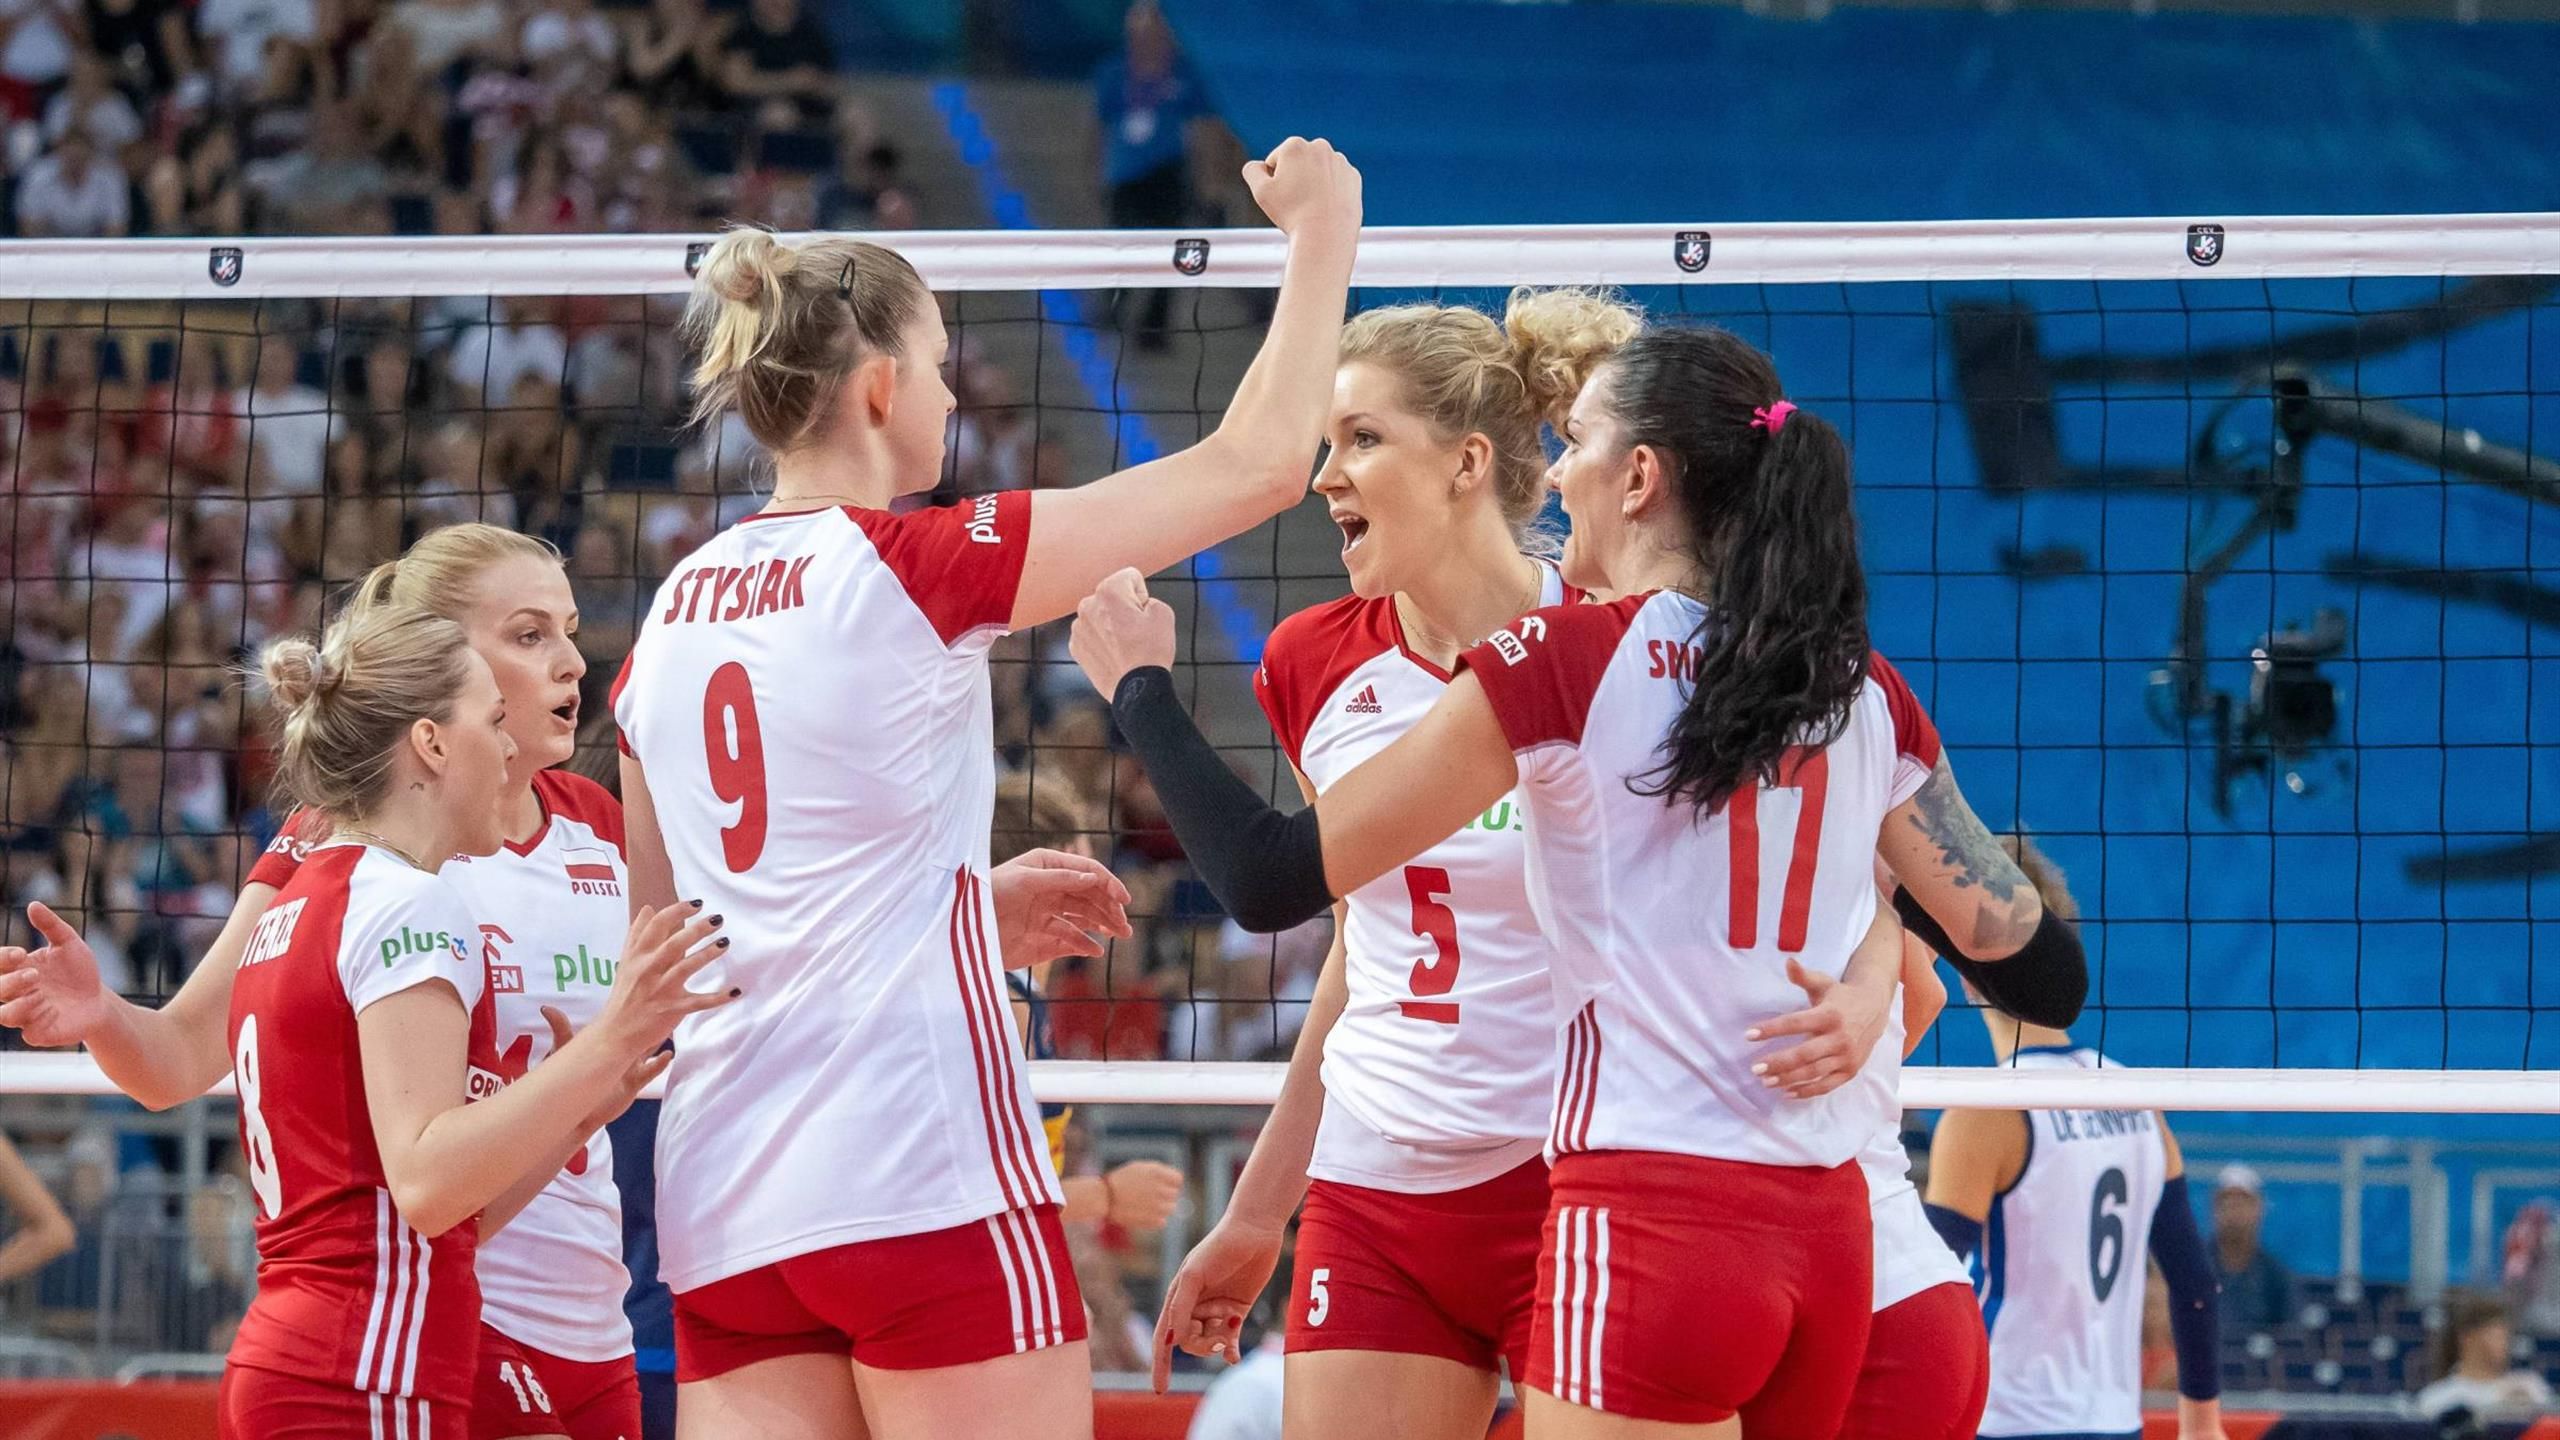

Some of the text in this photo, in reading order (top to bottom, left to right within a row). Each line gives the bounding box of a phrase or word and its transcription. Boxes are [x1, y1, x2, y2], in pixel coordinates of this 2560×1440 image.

[664, 554, 816, 625] STYSIAK
[1345, 703, 1382, 713] adidas
[703, 661, 768, 873] 9
[1708, 742, 1829, 953] 17
[571, 881, 622, 898] POLSKA
[380, 926, 450, 968] plus
[1403, 864, 1460, 997] 5
[553, 943, 620, 992] plu
[235, 1013, 283, 1221] 8
[2089, 1166, 2128, 1305] 6
[1307, 1268, 1330, 1327] 5
[499, 1360, 552, 1414] 16
